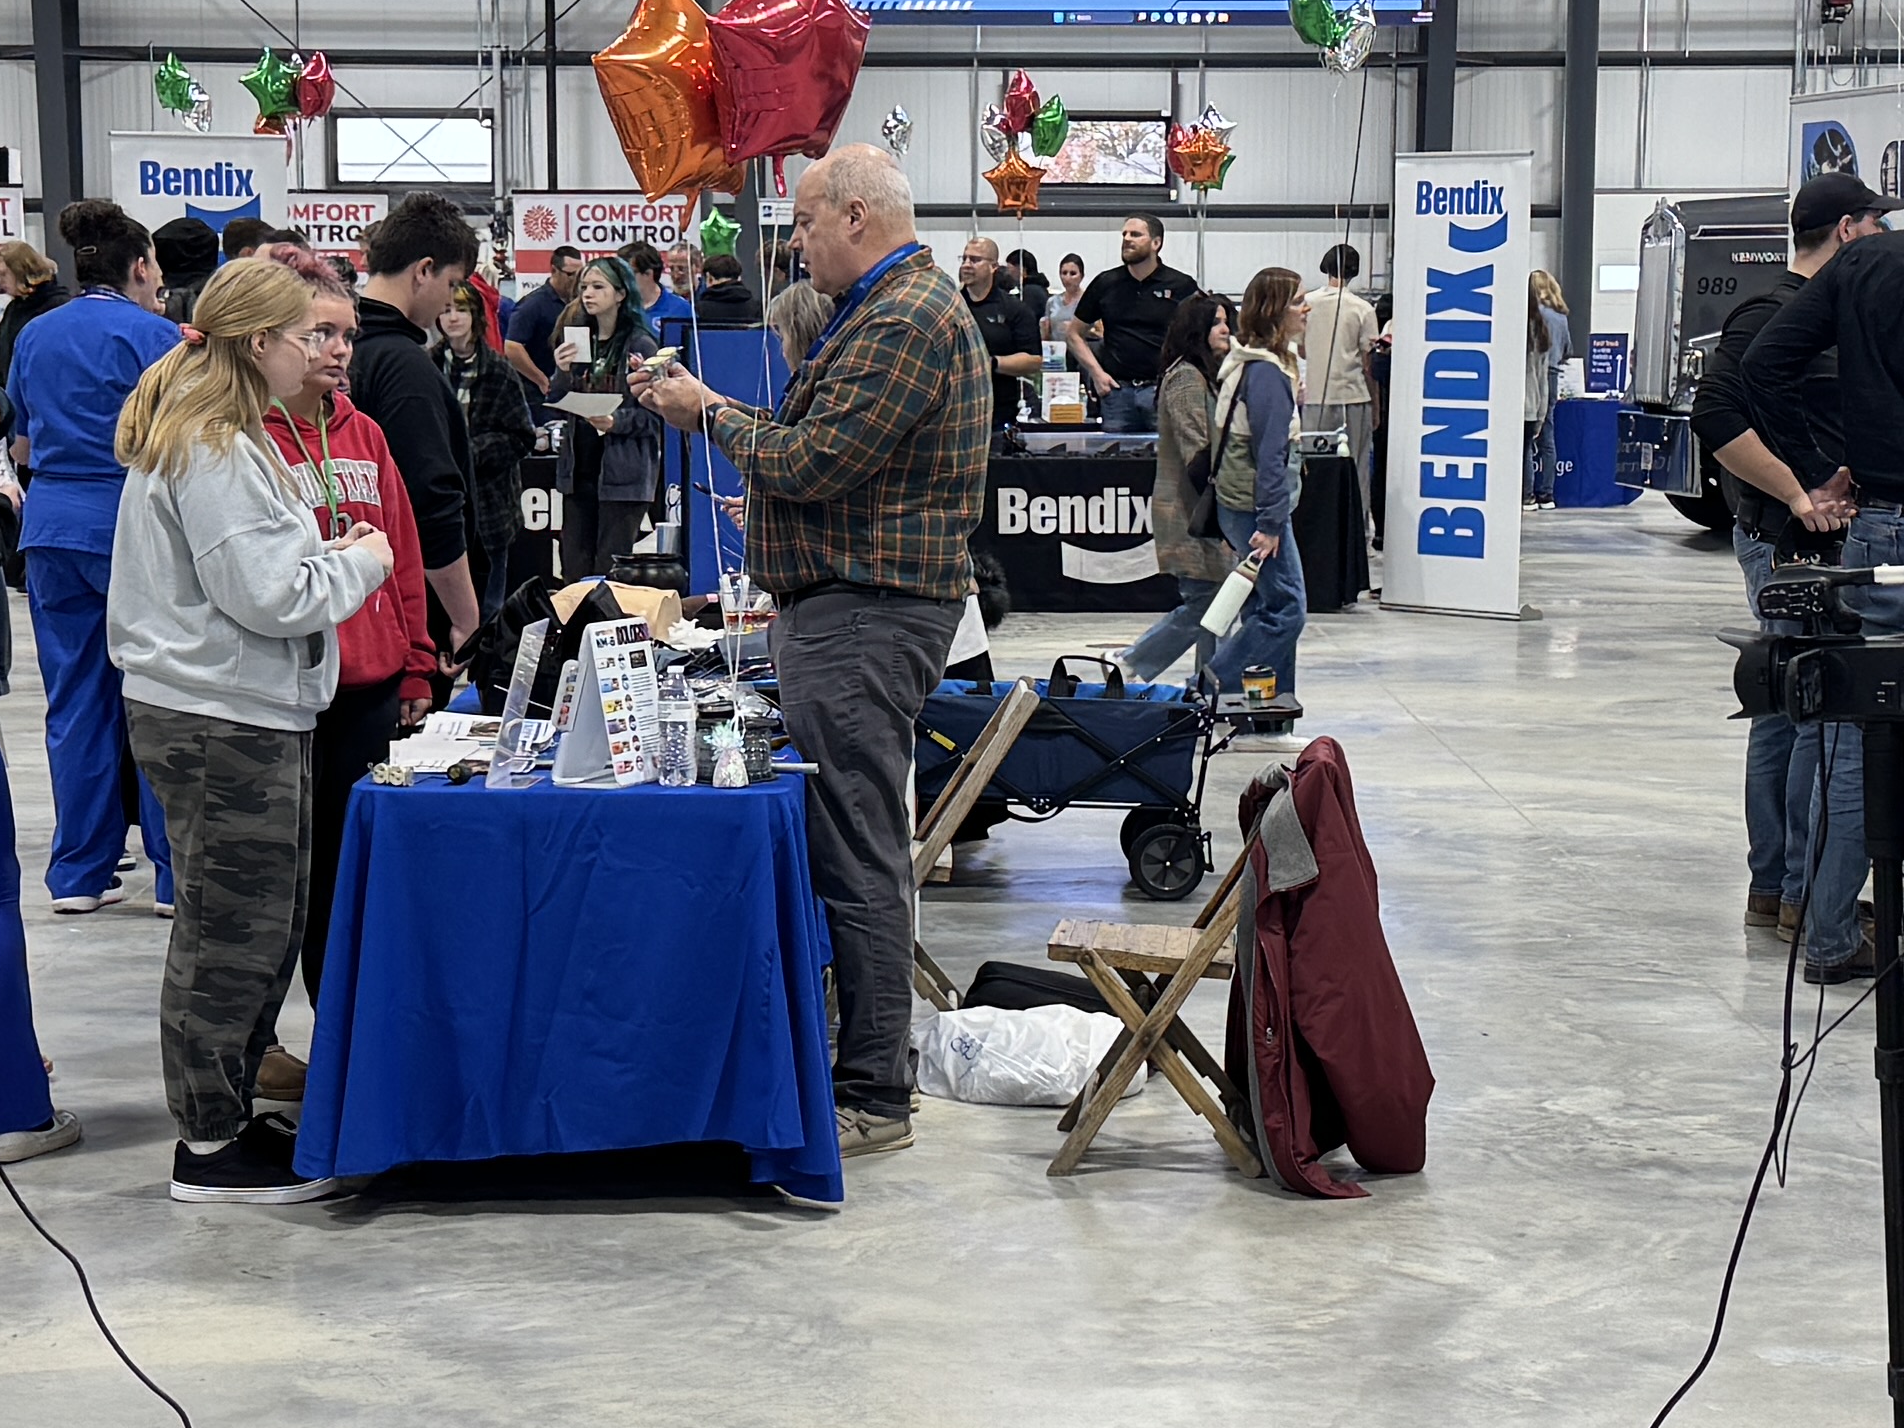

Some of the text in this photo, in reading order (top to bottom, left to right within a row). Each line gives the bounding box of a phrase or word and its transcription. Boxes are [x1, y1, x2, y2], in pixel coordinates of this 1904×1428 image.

[139, 160, 254, 196] Bendix
[287, 203, 376, 222] MFORT
[576, 203, 685, 223] COMFORT
[1416, 179, 1504, 215] Bendix
[1696, 276, 1738, 296] 989
[1417, 263, 1495, 560] BENDIX
[997, 486, 1154, 535] Bendix
